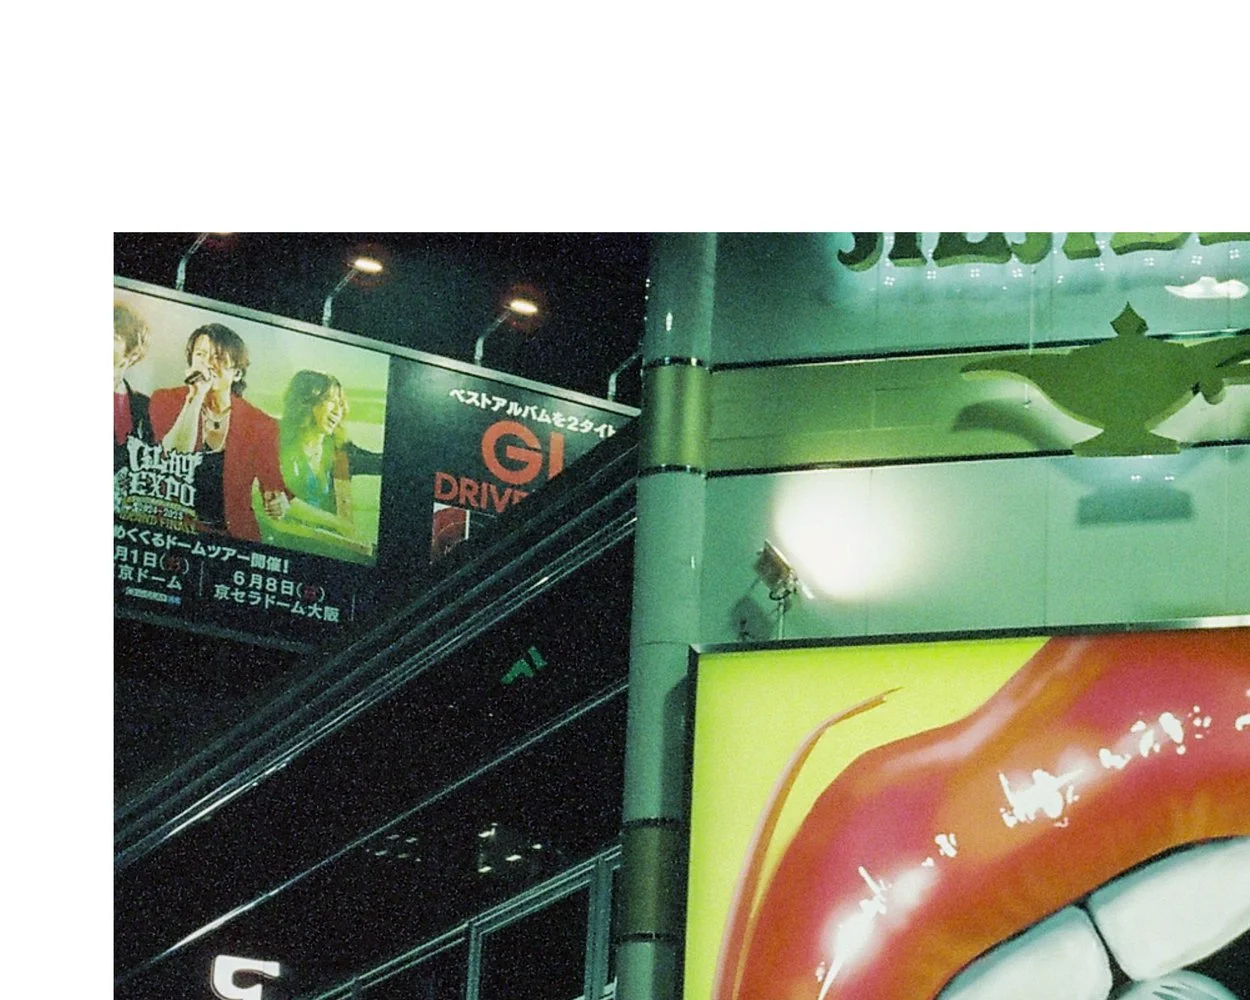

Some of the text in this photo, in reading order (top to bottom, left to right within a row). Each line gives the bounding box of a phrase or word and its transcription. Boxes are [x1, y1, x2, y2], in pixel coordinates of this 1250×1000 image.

[214, 583, 340, 622] 京セラドーム大阪
